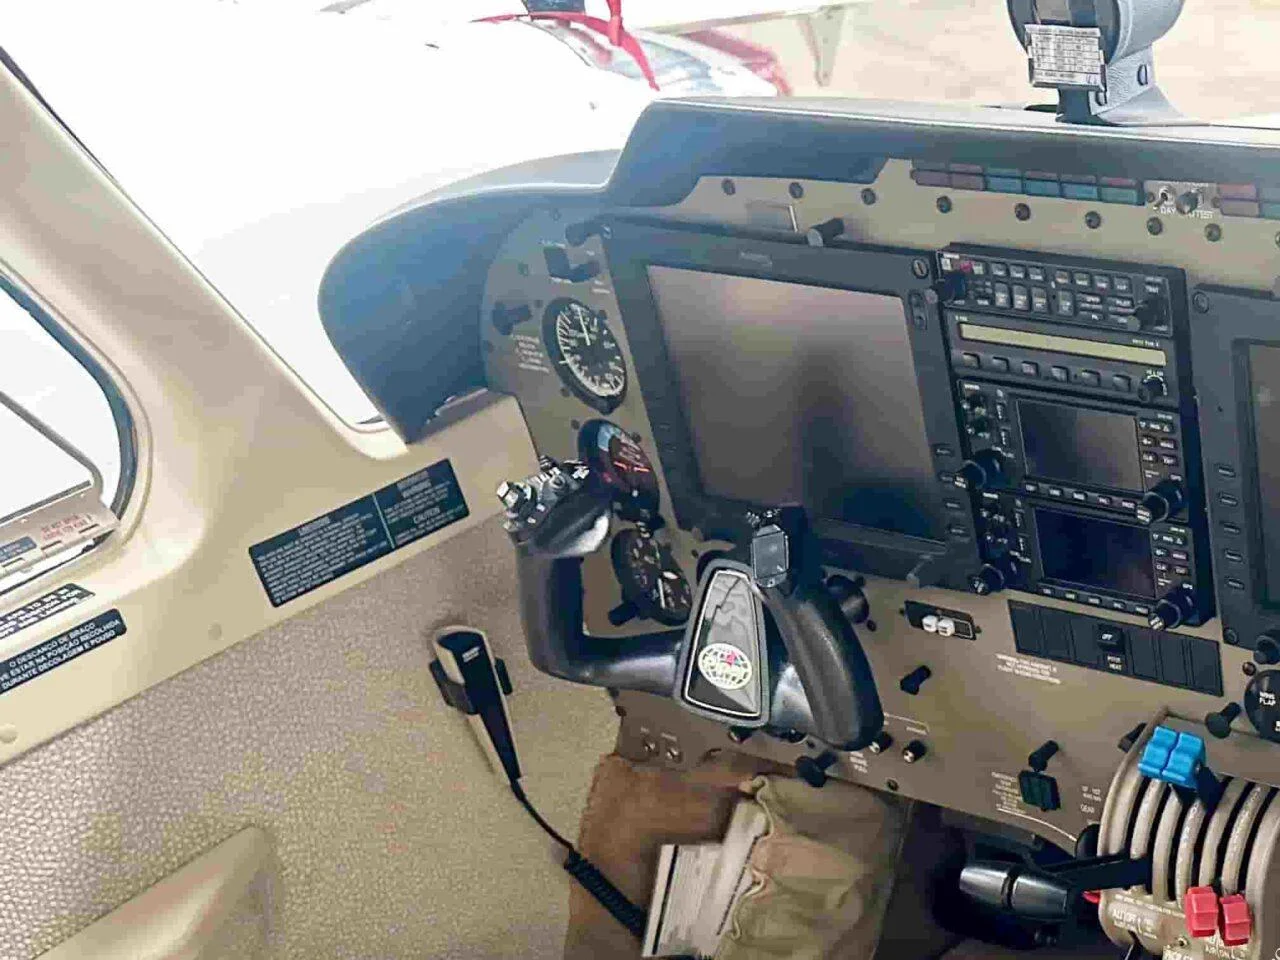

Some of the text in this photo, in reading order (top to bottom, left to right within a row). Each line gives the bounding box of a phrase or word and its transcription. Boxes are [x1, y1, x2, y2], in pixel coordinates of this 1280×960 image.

[1, 630, 116, 690] DURANTE DECOLAGEM E POUSO
[10, 661, 36, 677] ESTAR
[36, 655, 47, 665] NA
[80, 619, 120, 642] RECOLHIDA
[1259, 697, 1276, 706] FLAP
